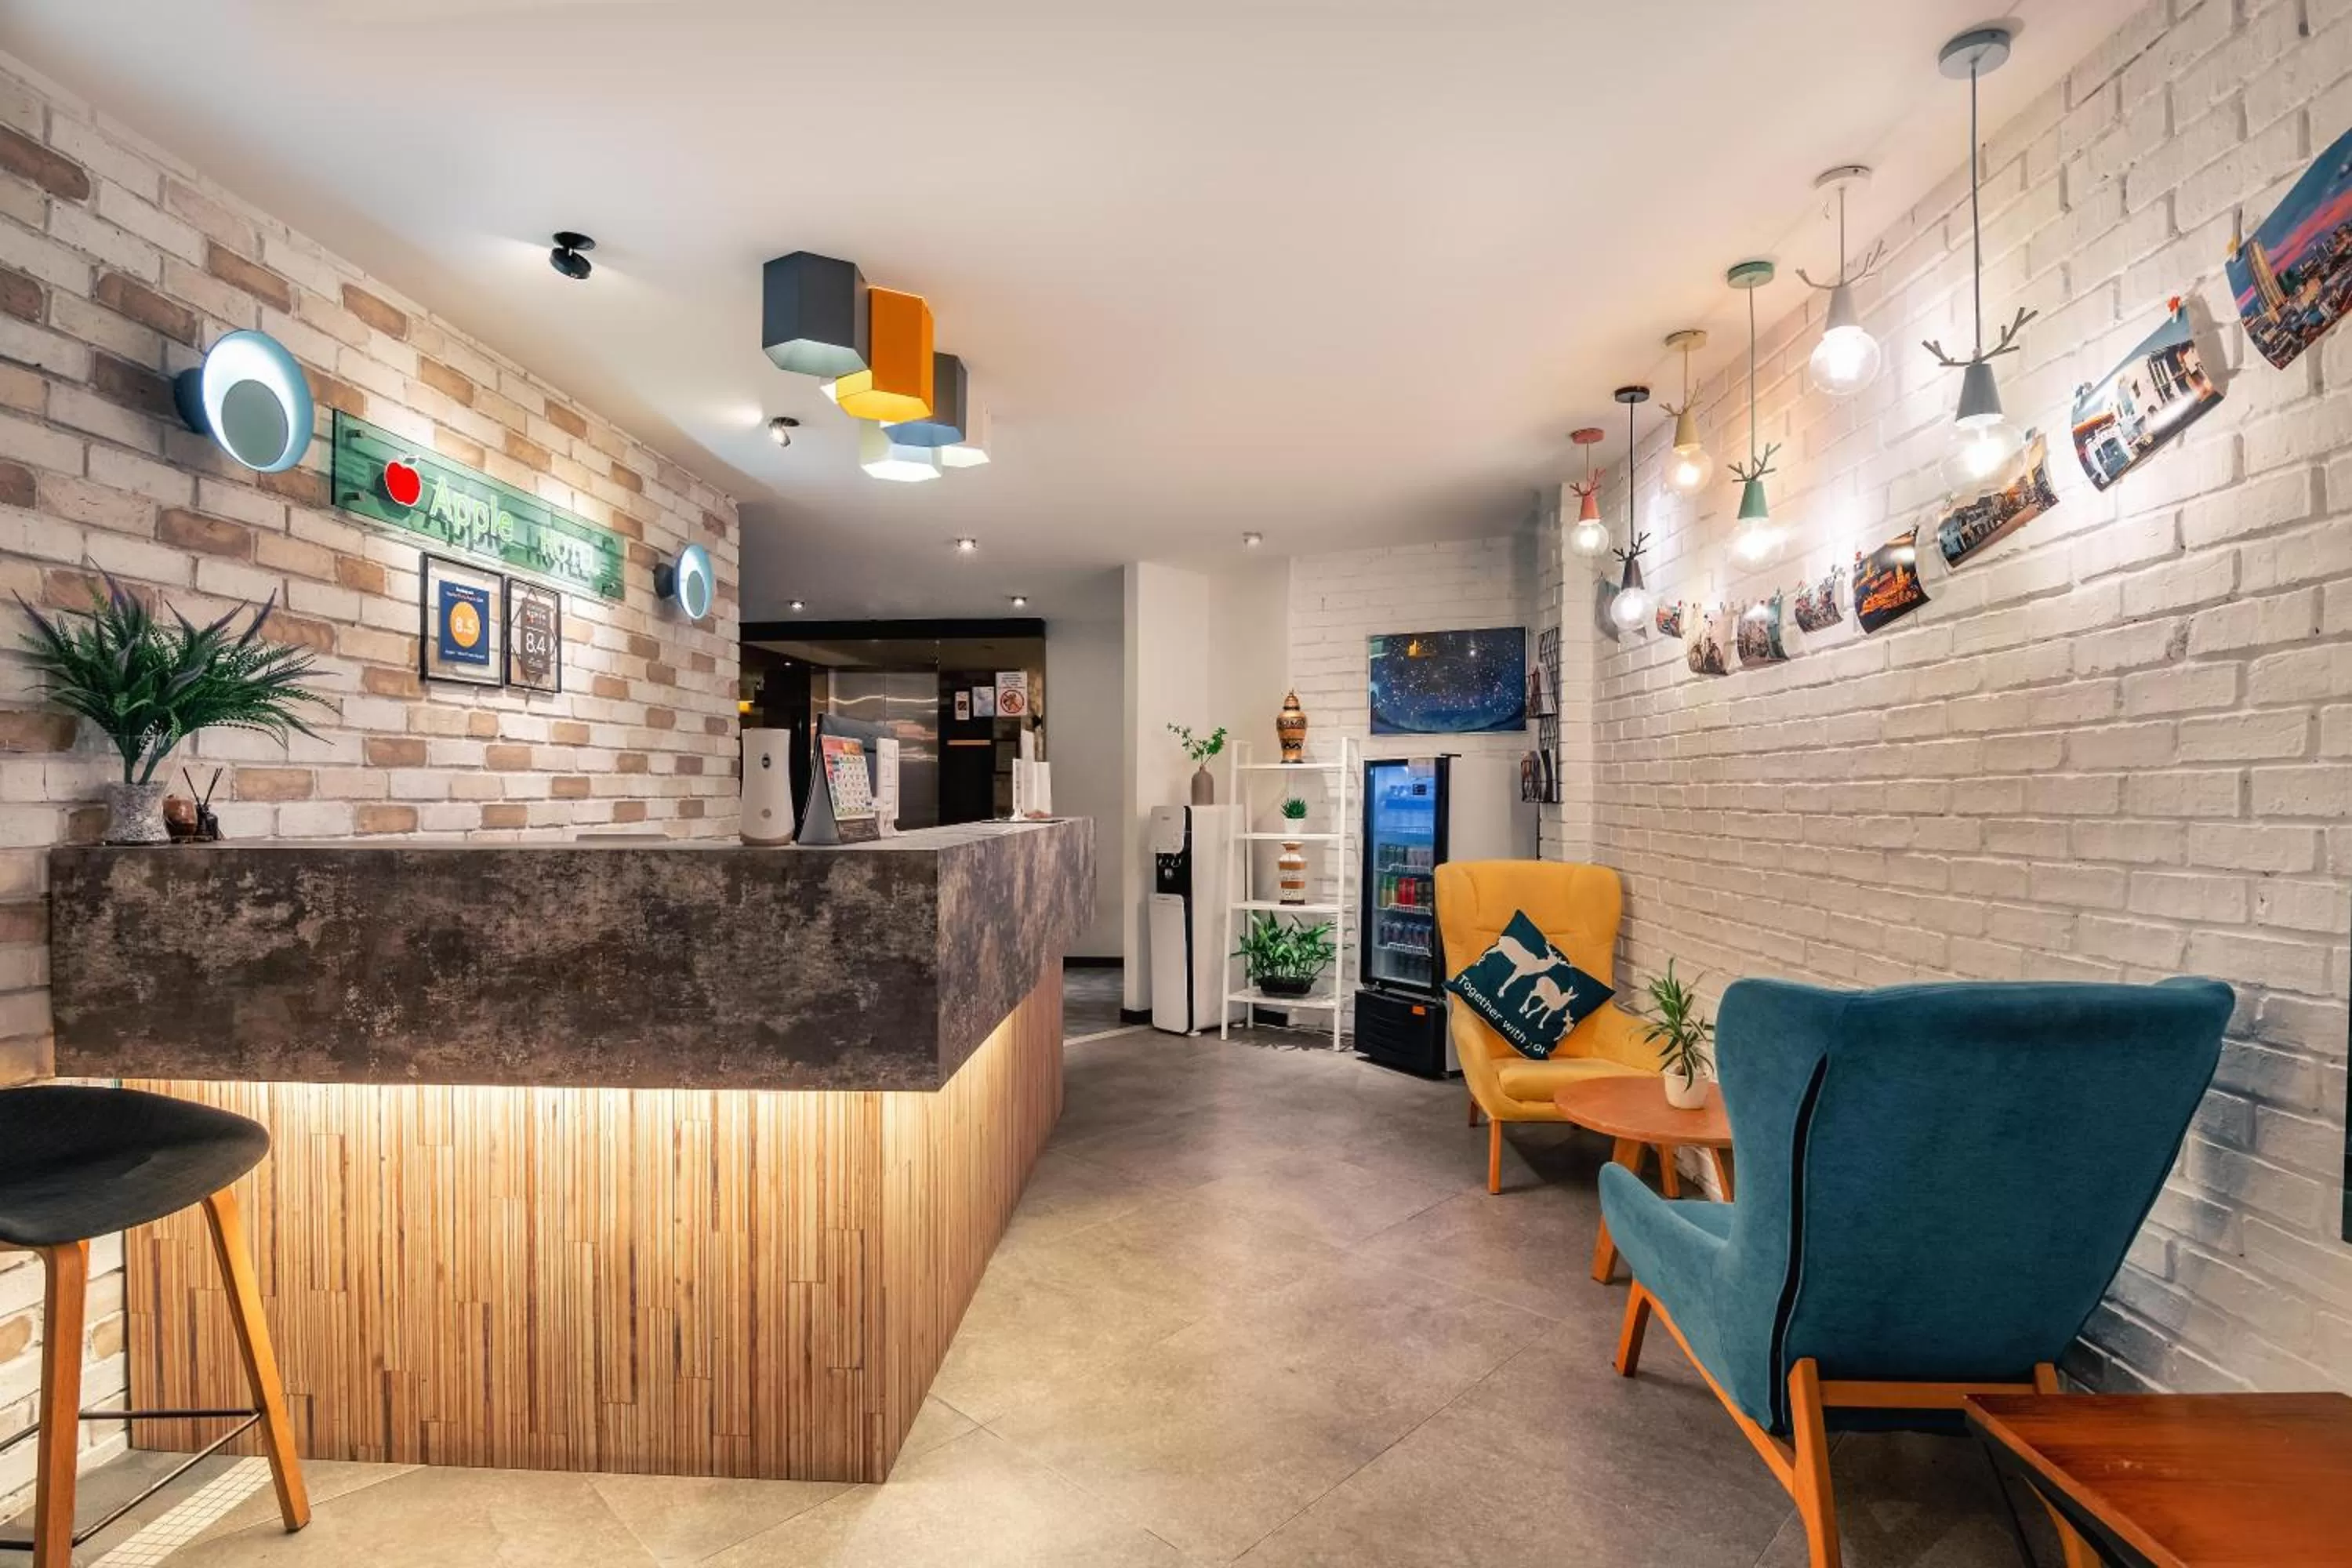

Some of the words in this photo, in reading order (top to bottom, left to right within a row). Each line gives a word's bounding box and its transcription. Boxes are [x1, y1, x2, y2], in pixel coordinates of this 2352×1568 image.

[428, 475, 514, 542] Apple
[456, 617, 476, 635] 8.5
[526, 632, 546, 655] 8.4
[1457, 974, 1503, 1020] Together
[1502, 1020, 1526, 1044] with
